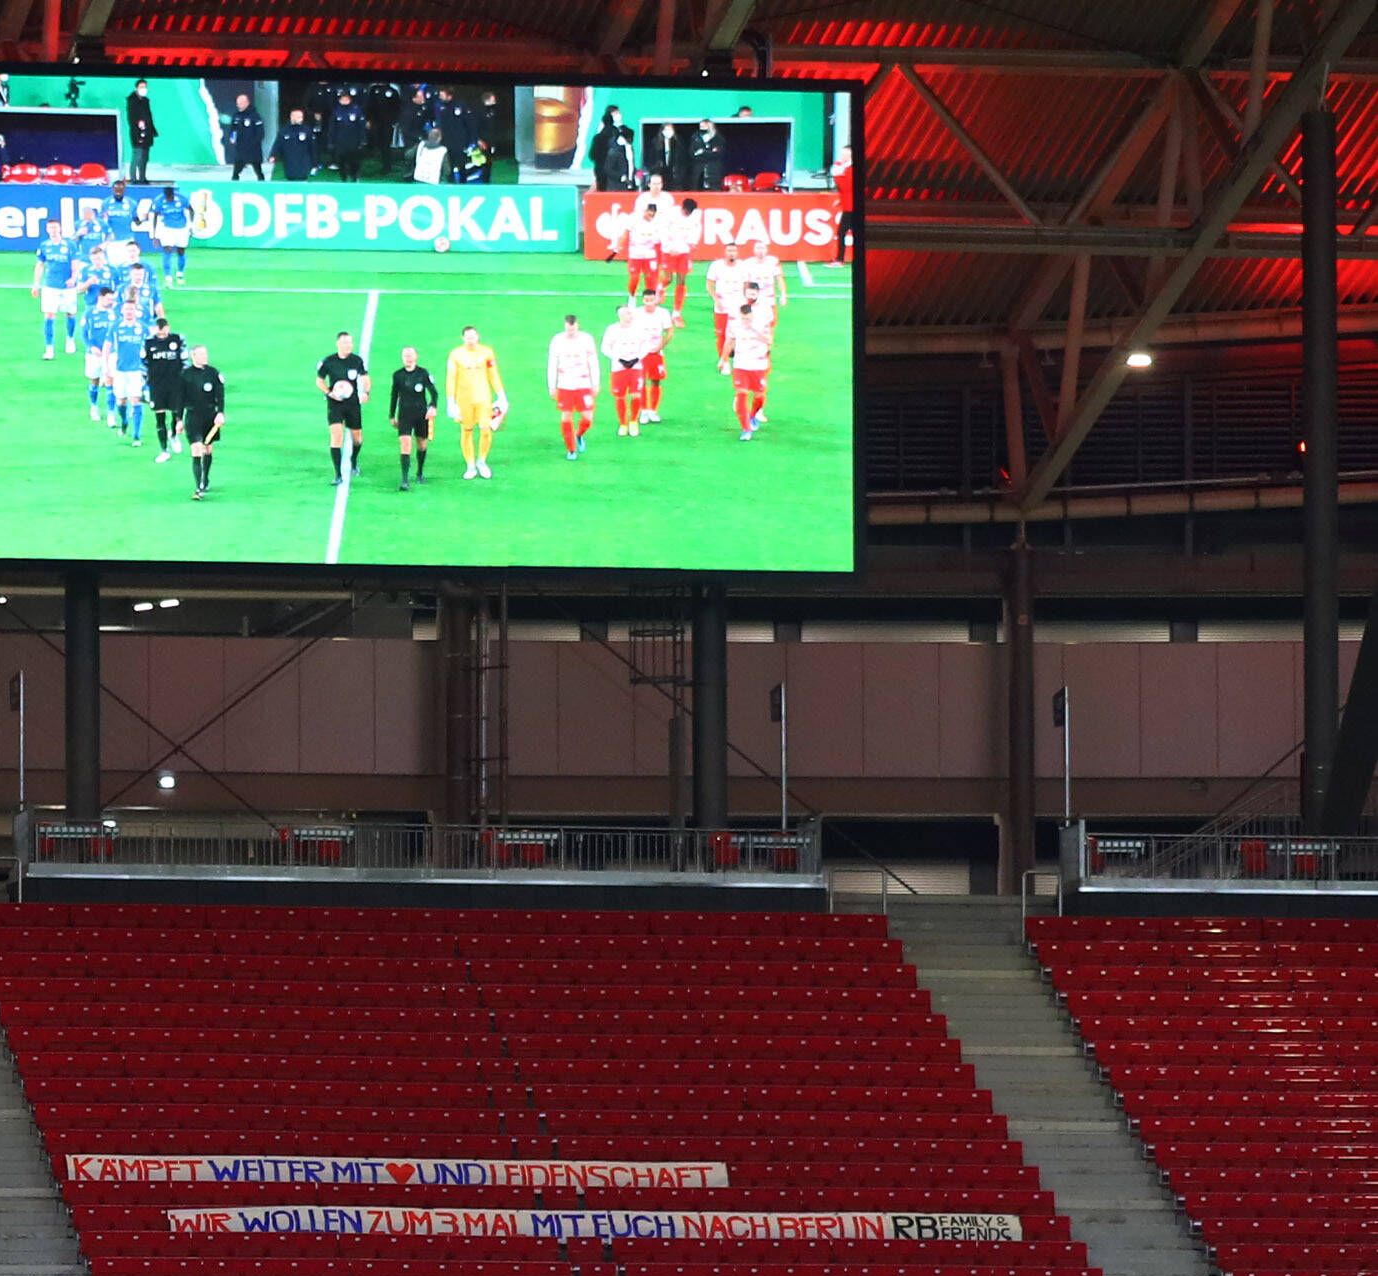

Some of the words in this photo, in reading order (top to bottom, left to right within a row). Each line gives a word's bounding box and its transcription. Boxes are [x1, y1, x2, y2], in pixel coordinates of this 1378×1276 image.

[230, 192, 559, 241] DFB-POKAL
[72, 1157, 203, 1181] KÄMPFT
[208, 1159, 325, 1182] WEITER
[332, 1161, 384, 1184] MIT
[416, 1163, 487, 1185] UND
[170, 1212, 232, 1232] WIR
[238, 1209, 362, 1233] WOLLEN
[366, 1211, 432, 1235] ZUM
[530, 1213, 585, 1238] MIT
[593, 1213, 676, 1240] EUCH
[682, 1214, 771, 1239] NACH
[776, 1215, 885, 1240] BERLIN
[892, 1215, 940, 1240] RB
[939, 1216, 992, 1227] FAMILY
[996, 1216, 1008, 1226] &
[941, 1227, 1012, 1241] FRIENDS
